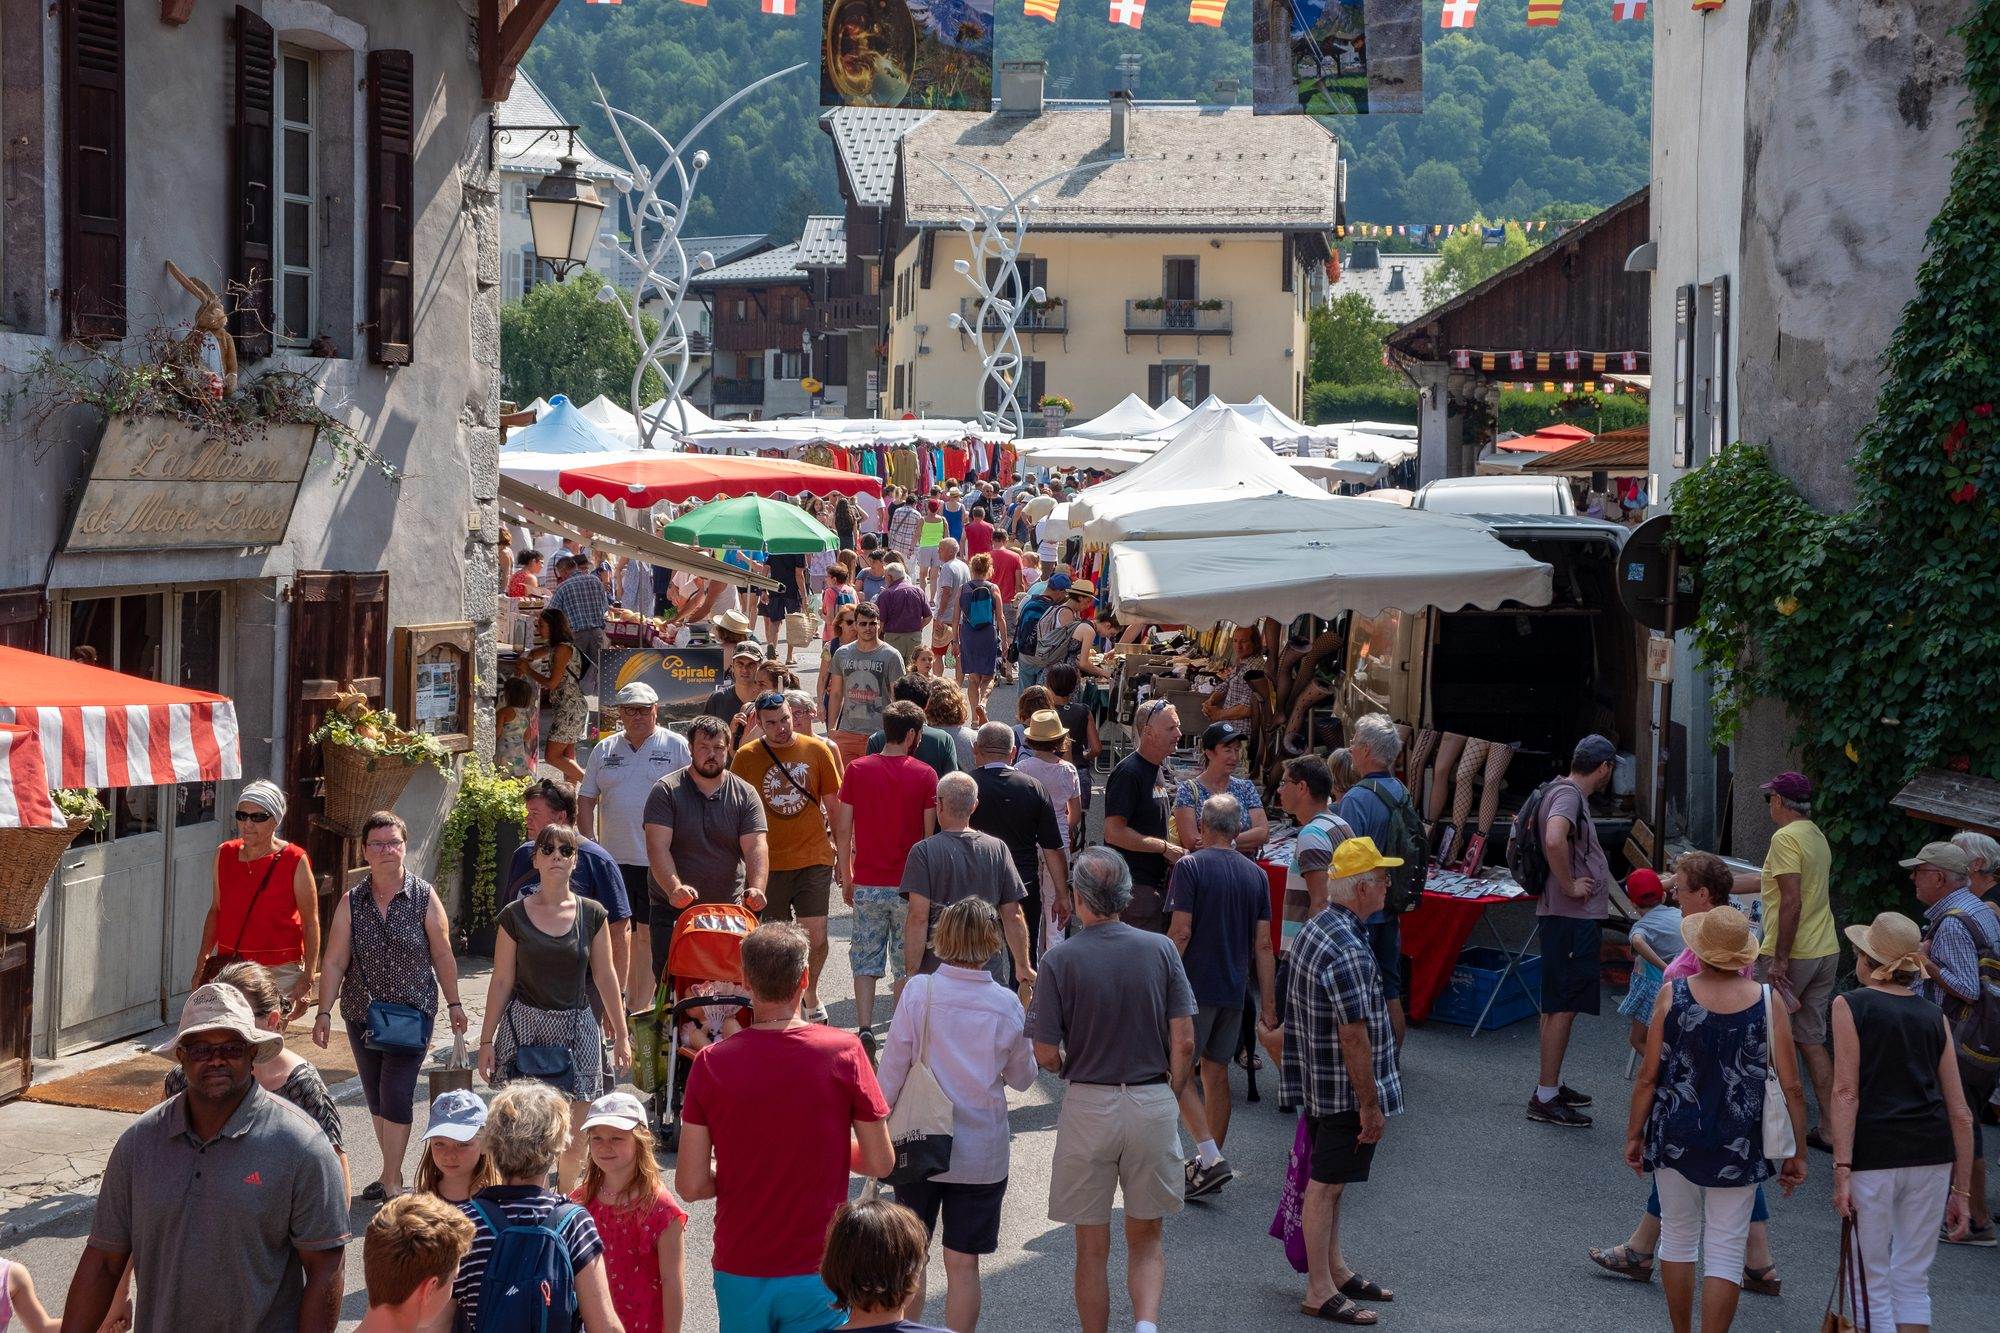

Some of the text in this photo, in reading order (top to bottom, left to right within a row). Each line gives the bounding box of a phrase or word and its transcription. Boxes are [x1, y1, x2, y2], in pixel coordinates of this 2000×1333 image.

[129, 433, 280, 479] La Maison
[81, 490, 281, 534] de Marie Louise
[671, 666, 716, 681] spirale
[906, 1133, 927, 1143] PARIS
